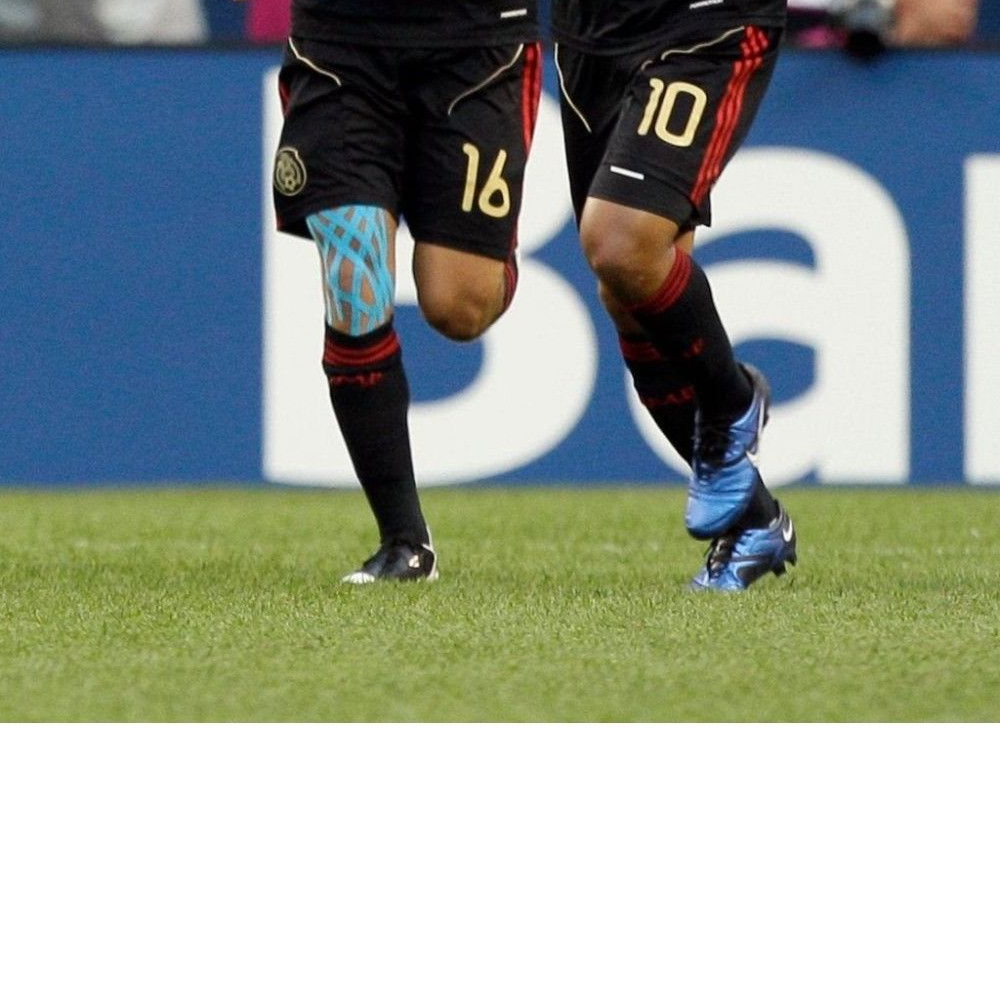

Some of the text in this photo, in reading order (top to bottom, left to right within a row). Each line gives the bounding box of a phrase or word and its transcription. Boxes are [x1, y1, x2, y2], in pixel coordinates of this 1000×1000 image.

[637, 78, 707, 147] 10
[462, 142, 510, 218] 16
[262, 66, 1000, 488] Ba
